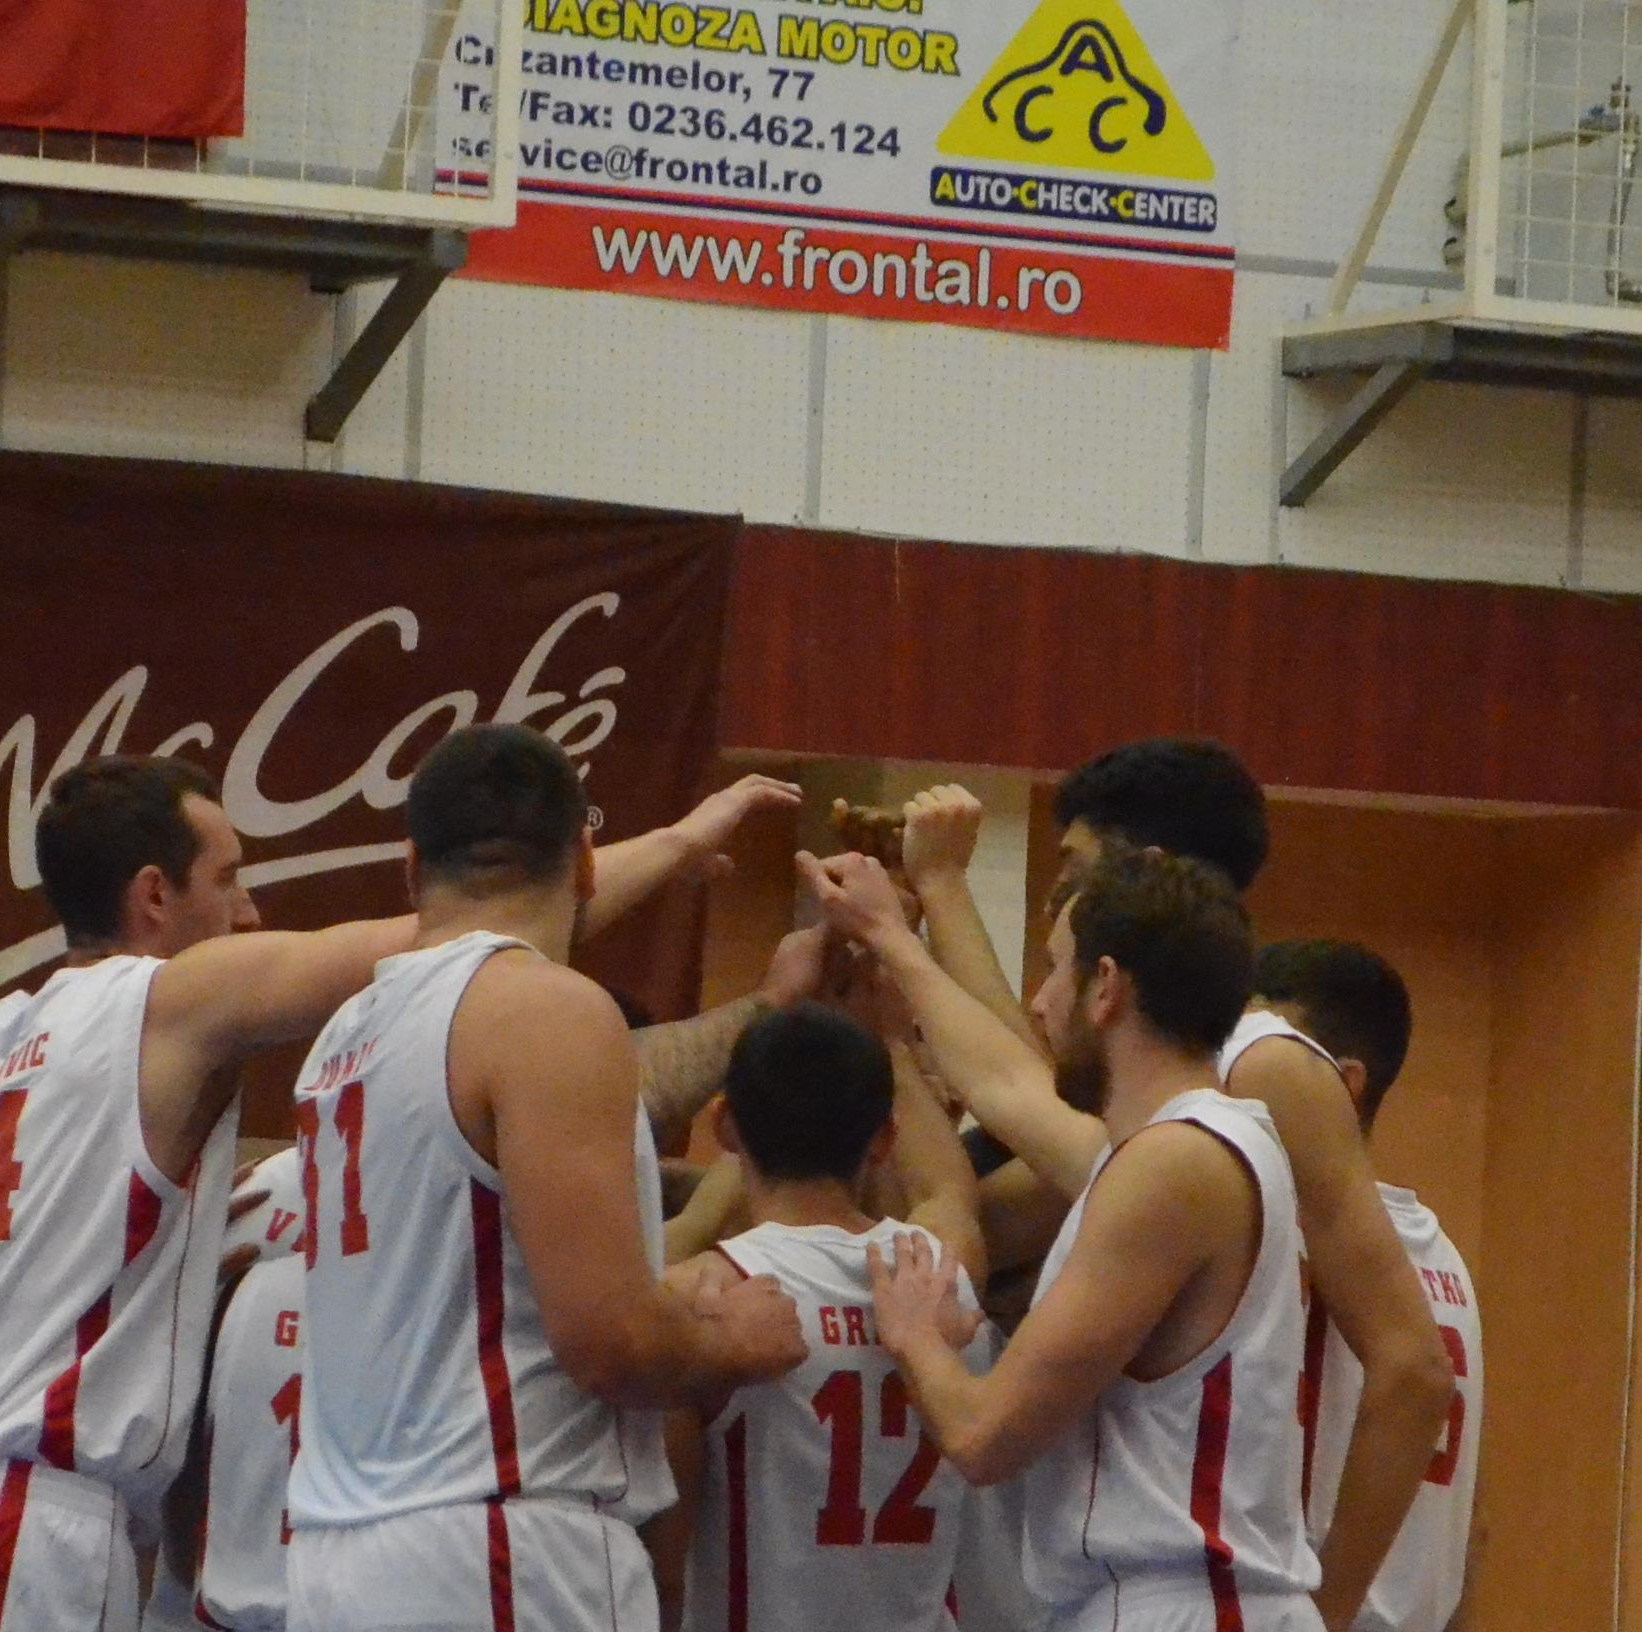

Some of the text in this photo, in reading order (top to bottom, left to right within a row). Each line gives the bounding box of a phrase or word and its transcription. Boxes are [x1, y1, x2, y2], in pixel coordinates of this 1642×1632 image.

[522, 0, 960, 76] IAGNOZA MOTOR
[769, 67, 814, 100] 77
[629, 101, 901, 157] 0236.462.124
[591, 219, 1084, 316] www.frontal.ro
[811, 1369, 942, 1546] 12
